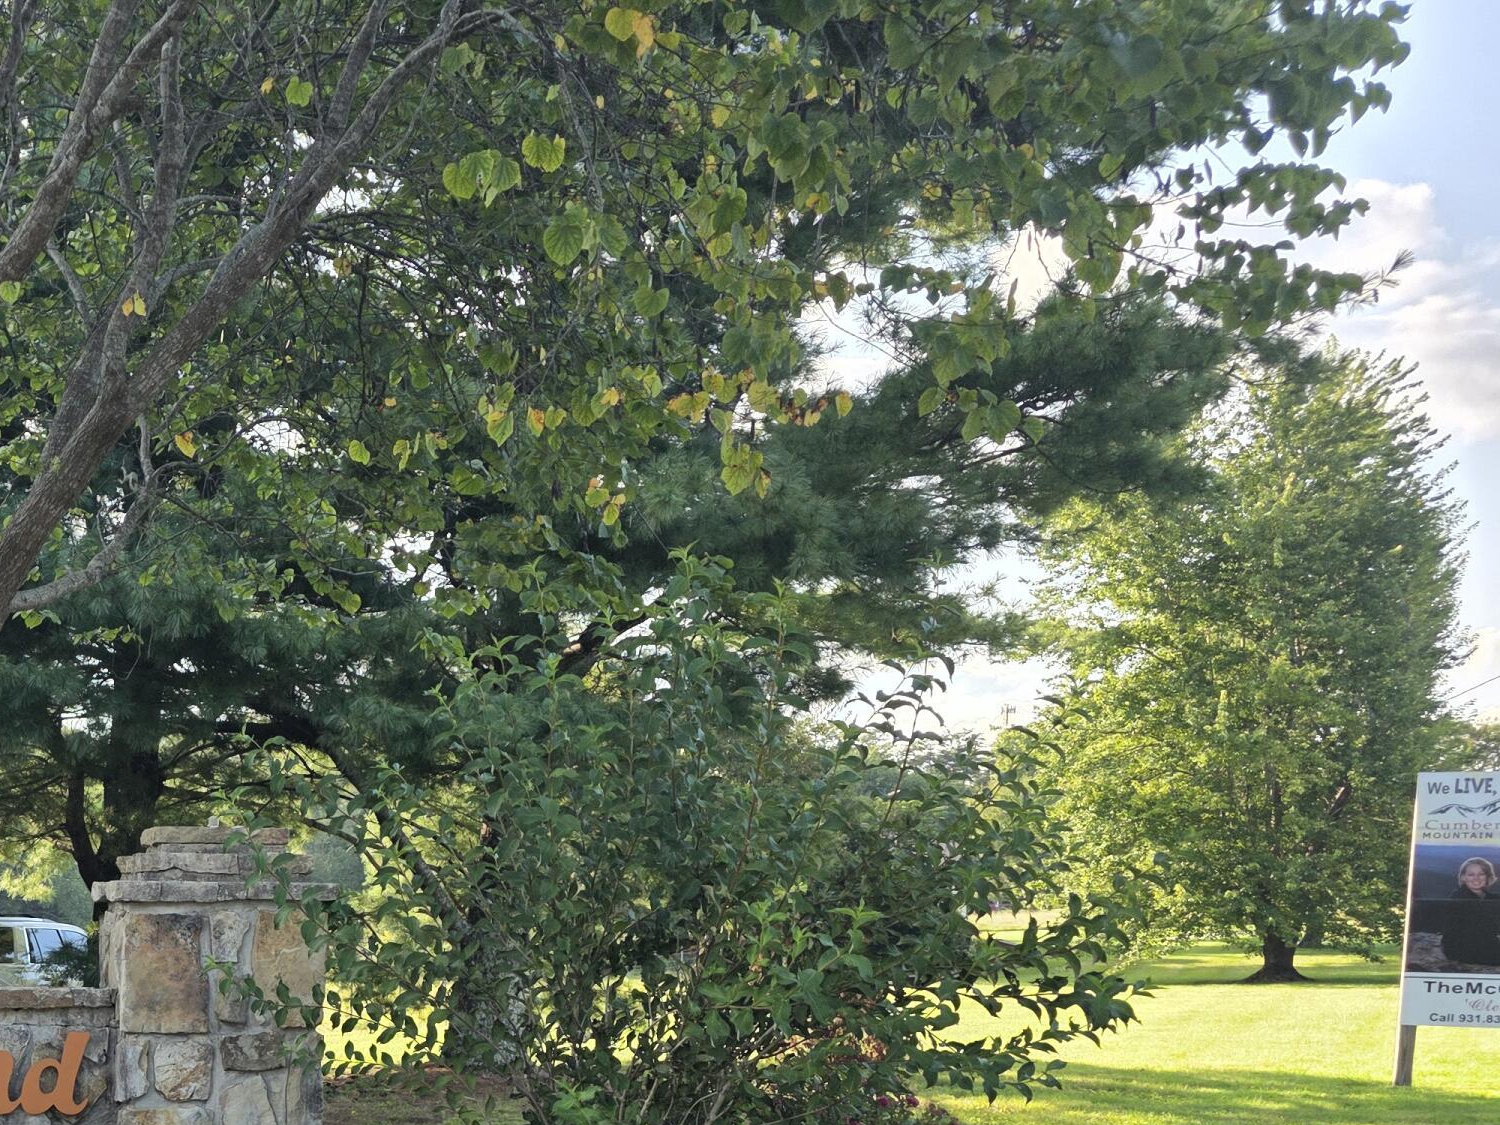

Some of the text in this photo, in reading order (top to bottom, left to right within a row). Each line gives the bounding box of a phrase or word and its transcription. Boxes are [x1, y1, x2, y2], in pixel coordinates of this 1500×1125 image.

[1427, 778, 1498, 796] We LIVE,
[1422, 832, 1493, 840] MOUNTAIN
[1423, 981, 1500, 995] TheMc
[1429, 1013, 1455, 1023] Call
